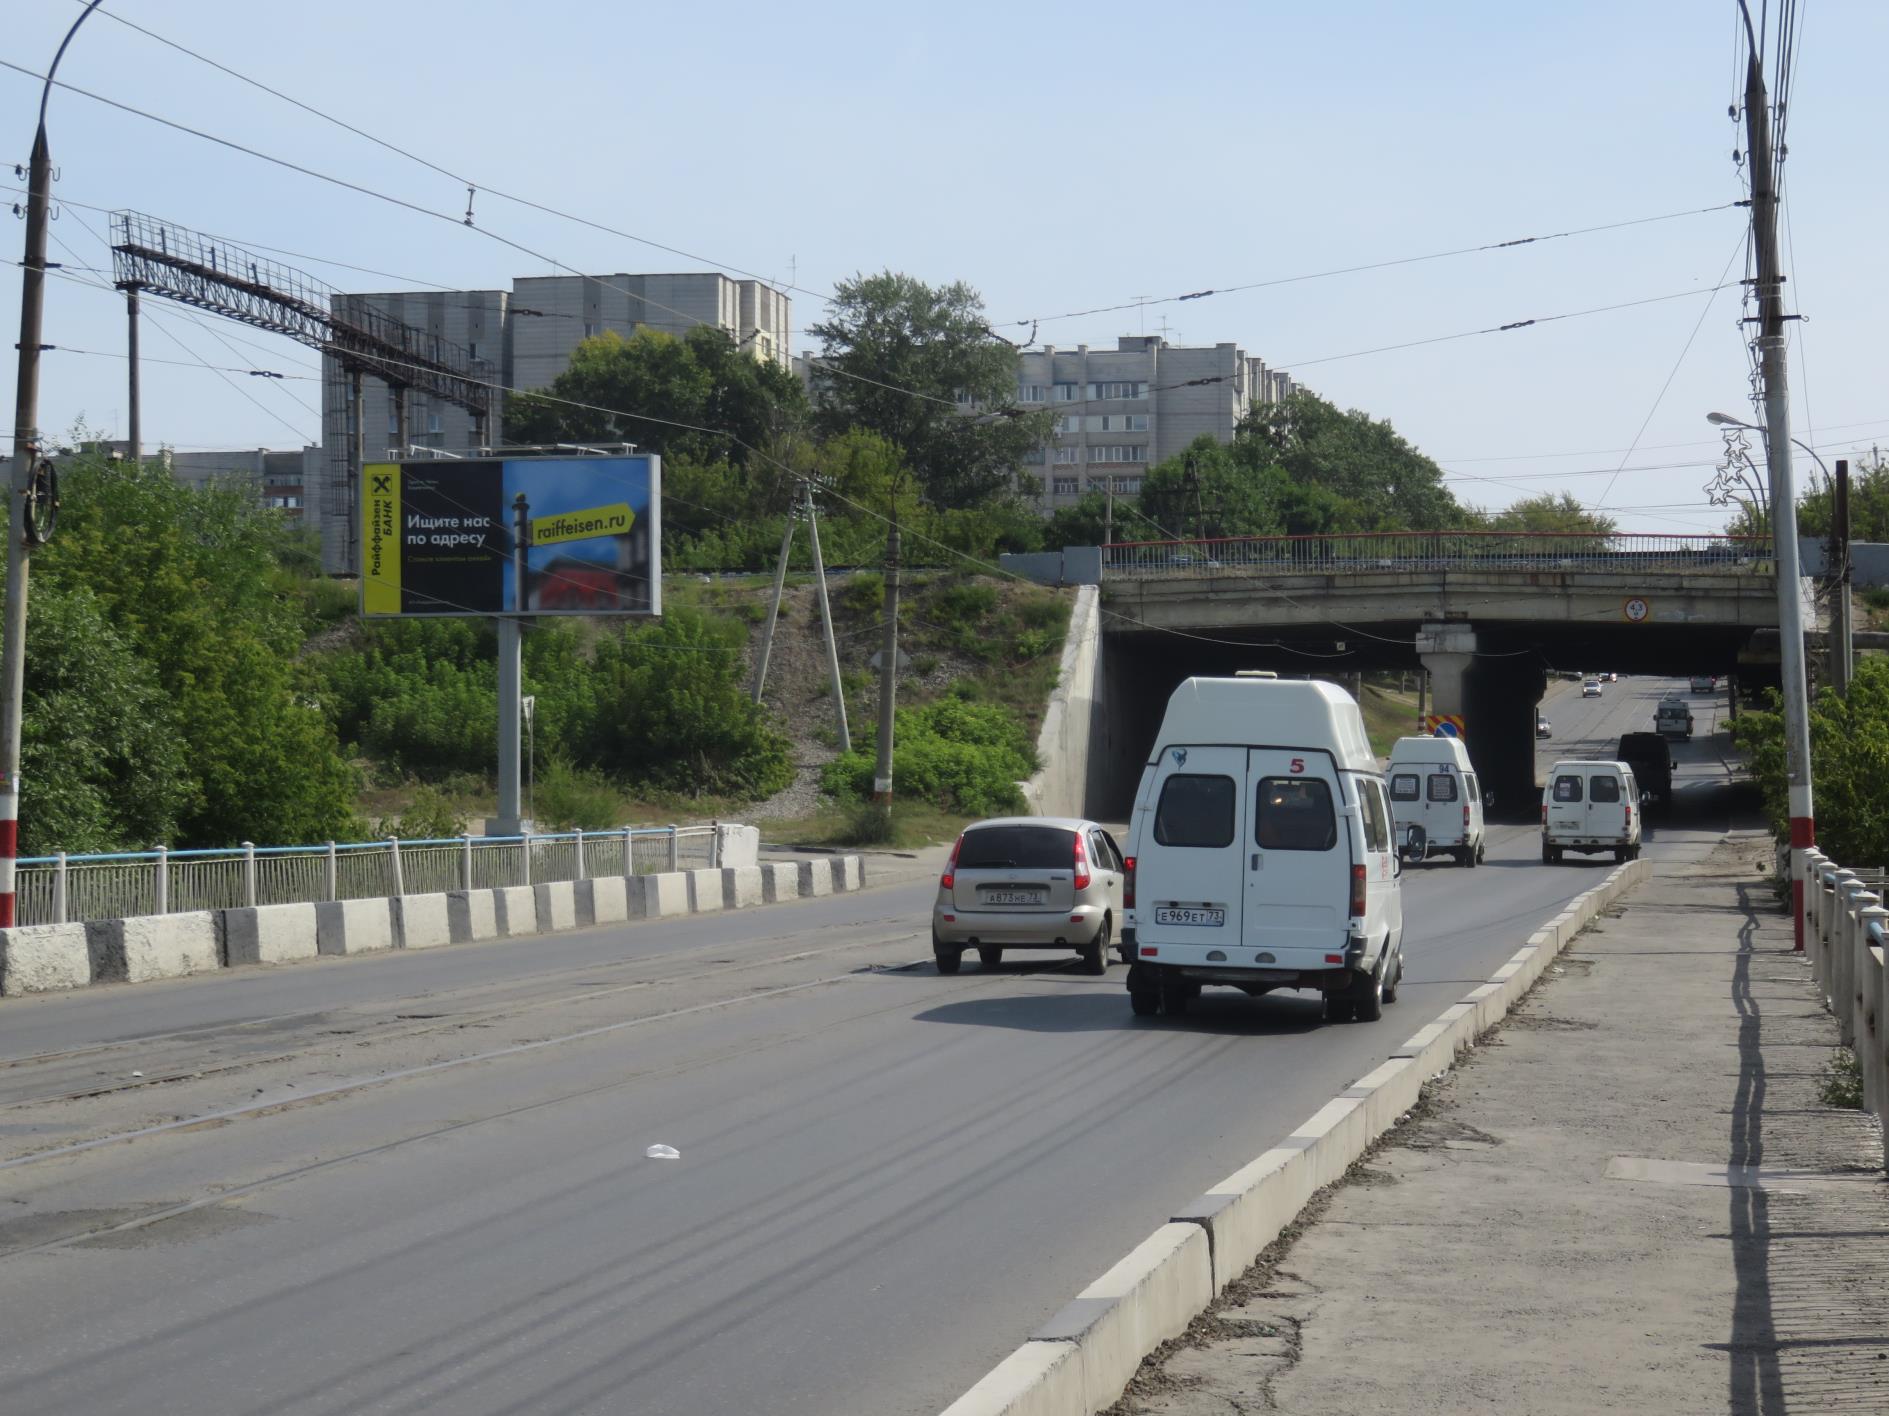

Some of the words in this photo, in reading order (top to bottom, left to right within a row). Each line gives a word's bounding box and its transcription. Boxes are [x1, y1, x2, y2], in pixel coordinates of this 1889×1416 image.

[383, 500, 393, 536] БАНК
[407, 514, 460, 530] Ищите
[463, 516, 491, 528] нас
[537, 514, 626, 539] raiffeisen.ru
[371, 499, 383, 576] Райффайзен
[407, 534, 427, 545] по
[430, 533, 486, 548] адресу
[1290, 758, 1305, 773] 5
